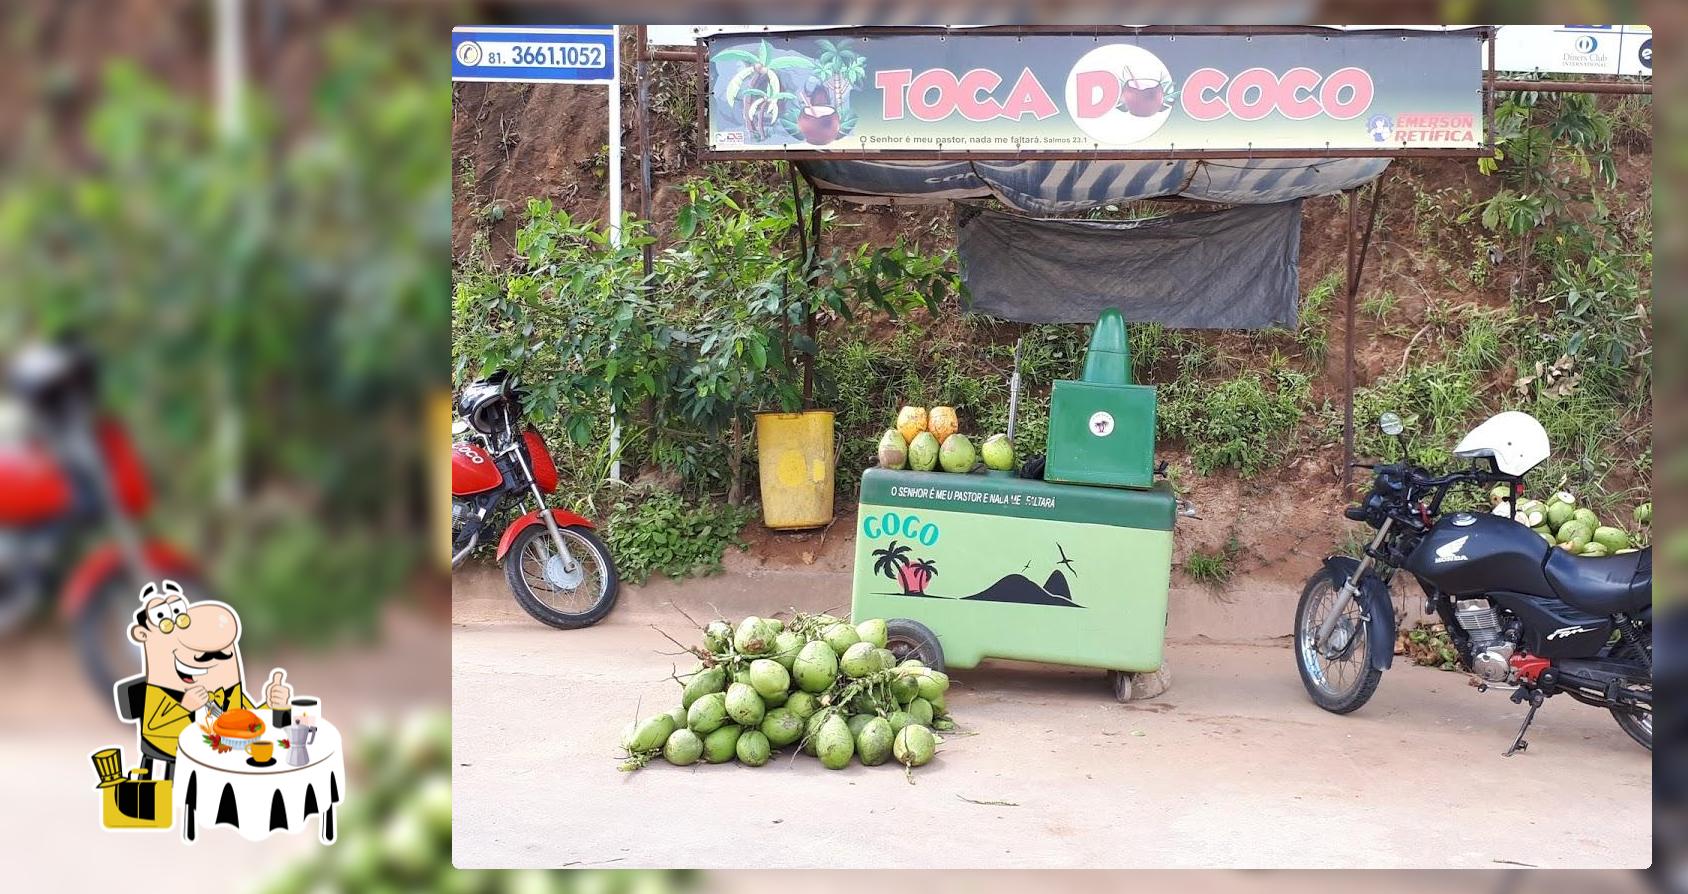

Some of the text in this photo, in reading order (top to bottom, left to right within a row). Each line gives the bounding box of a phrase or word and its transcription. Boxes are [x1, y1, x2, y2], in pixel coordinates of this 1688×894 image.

[512, 45, 602, 66] 3661.1052
[875, 66, 1060, 122] TOCA
[1180, 66, 1375, 121] COCO
[1396, 115, 1474, 128] EMERSON
[859, 135, 868, 144] O
[869, 135, 903, 144] Senhor
[935, 136, 968, 145] pastor,
[969, 135, 993, 144] nada
[1043, 136, 1071, 144] Salmos
[890, 486, 898, 497] O
[898, 486, 929, 499] SENHOR
[929, 487, 936, 500] É
[954, 490, 983, 503] PASTOR
[983, 492, 989, 504] E
[863, 512, 940, 546] COCO
